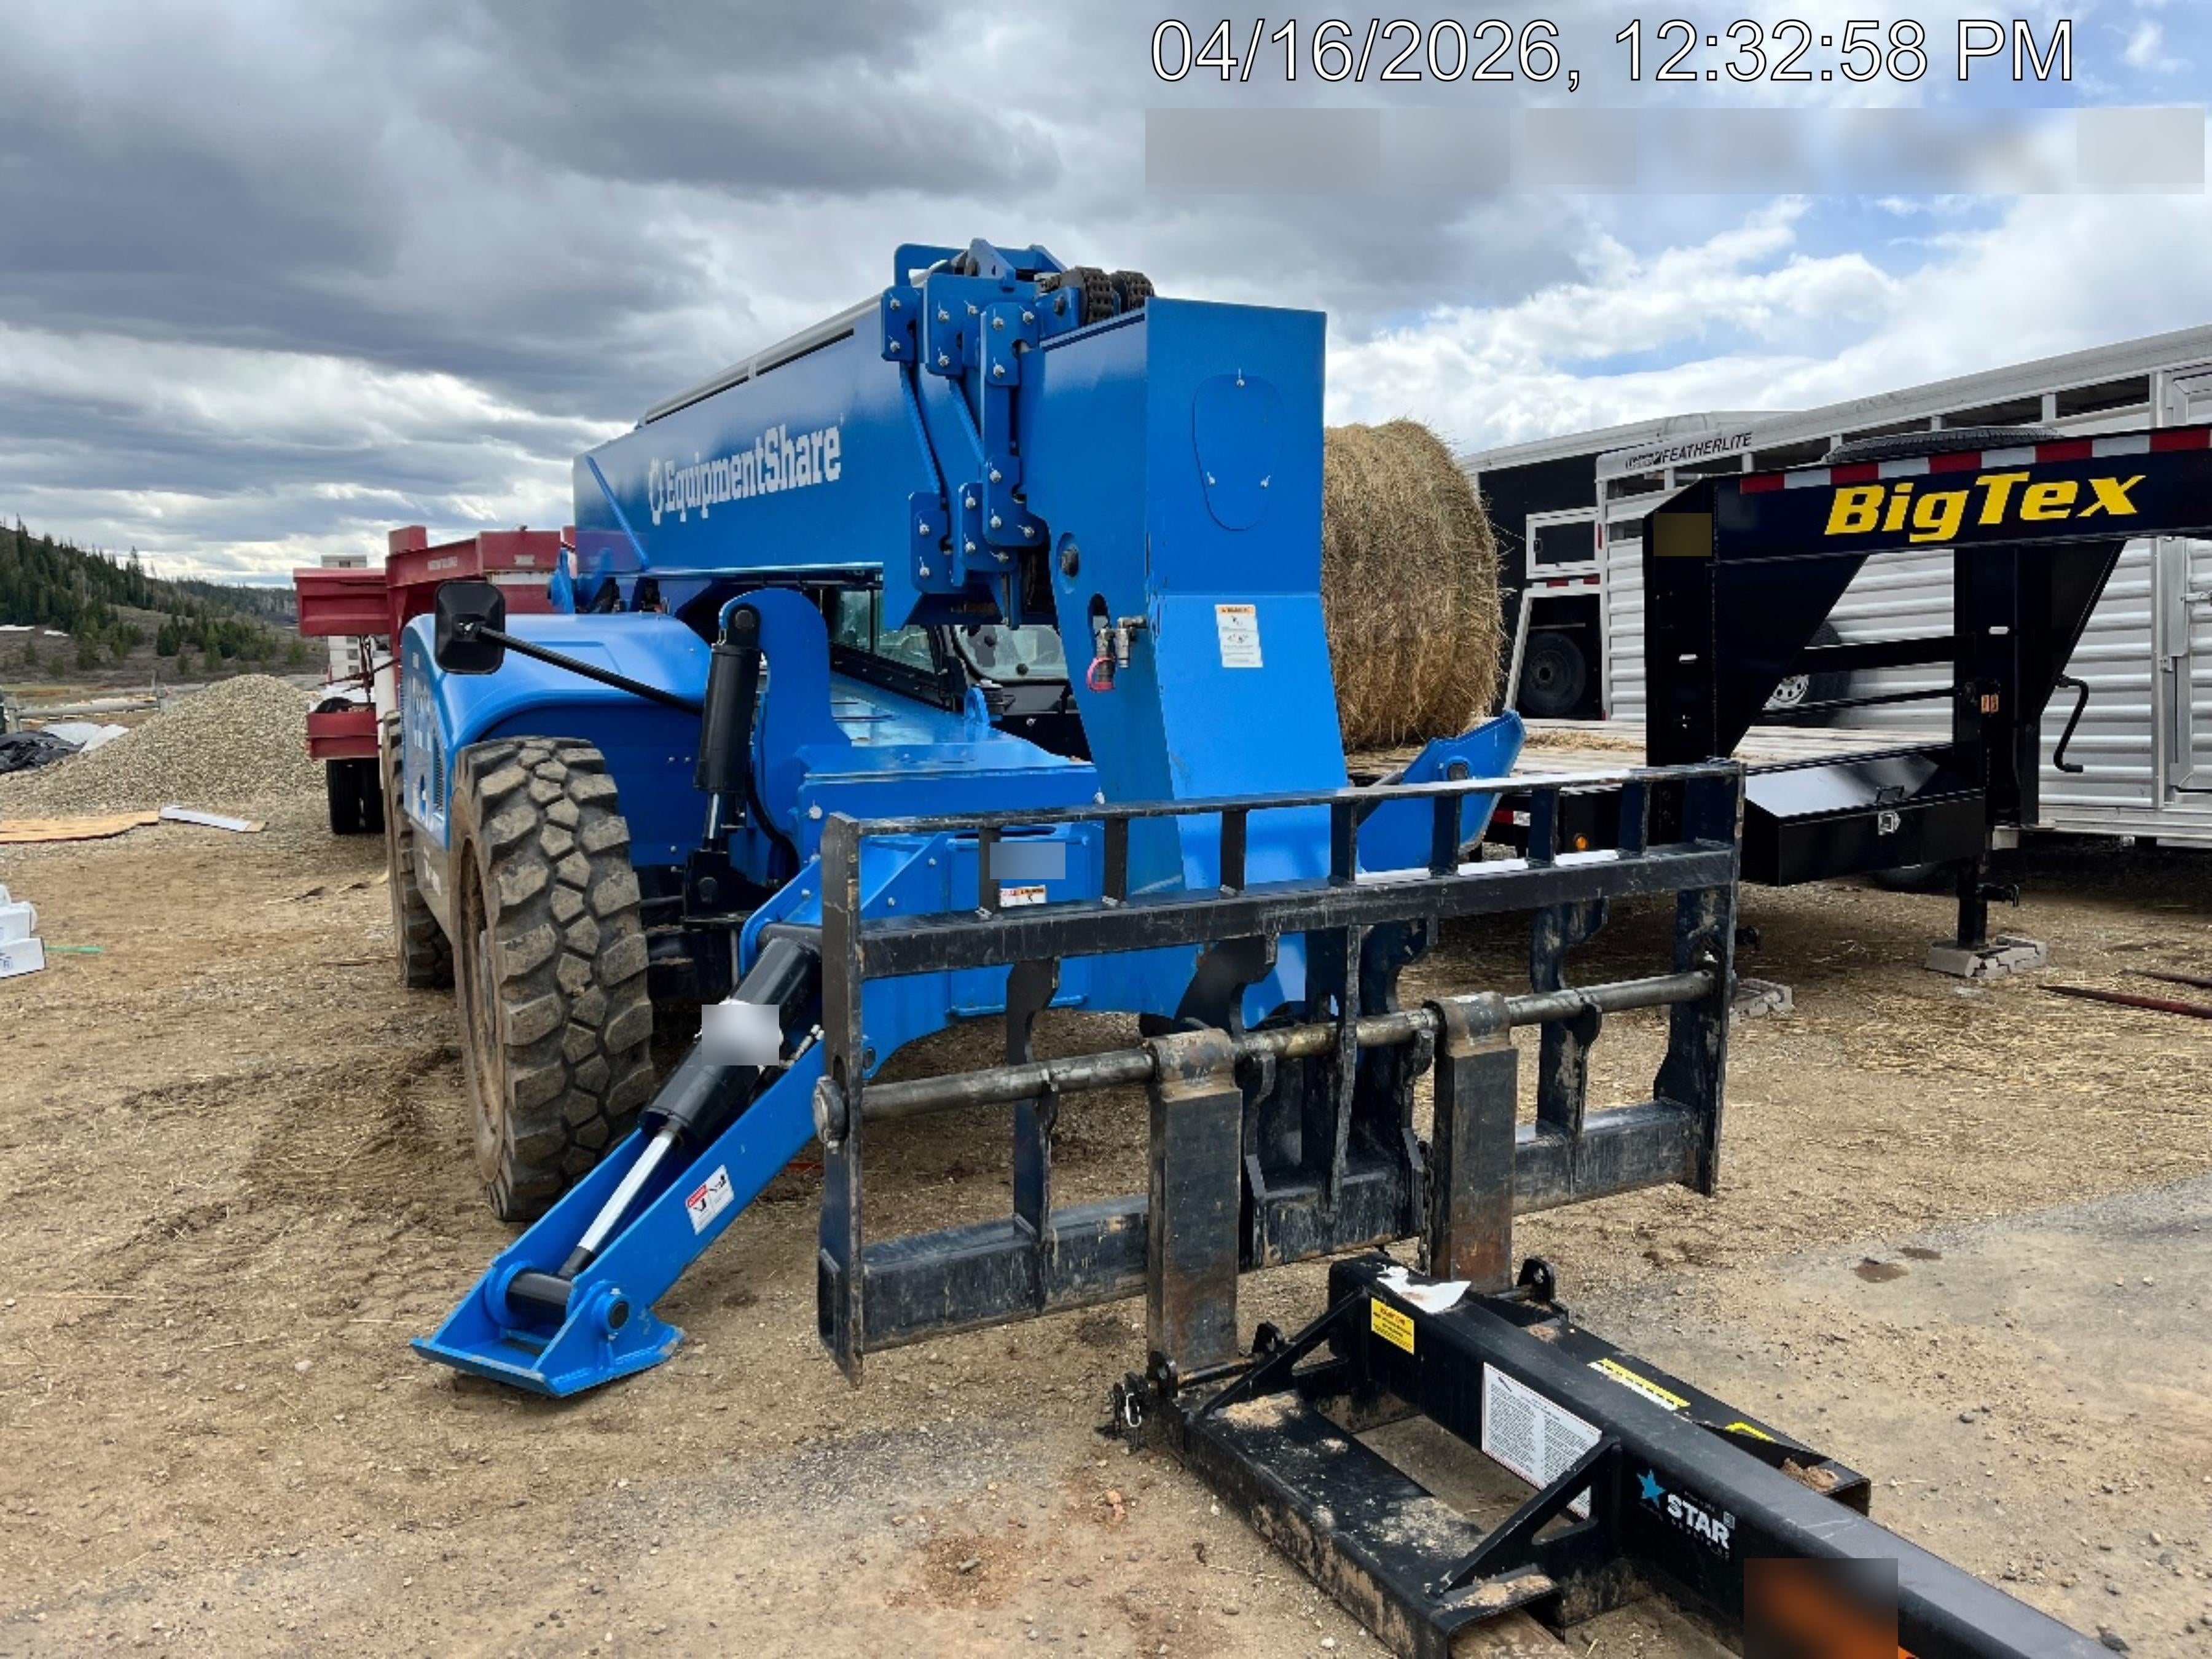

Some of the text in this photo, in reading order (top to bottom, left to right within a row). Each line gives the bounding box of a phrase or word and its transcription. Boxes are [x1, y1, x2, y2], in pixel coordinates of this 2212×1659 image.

[665, 423, 841, 522] EquipmentShare
[1663, 432, 1752, 463] FEATHERLITE
[1667, 1493, 1730, 1549] STAR
